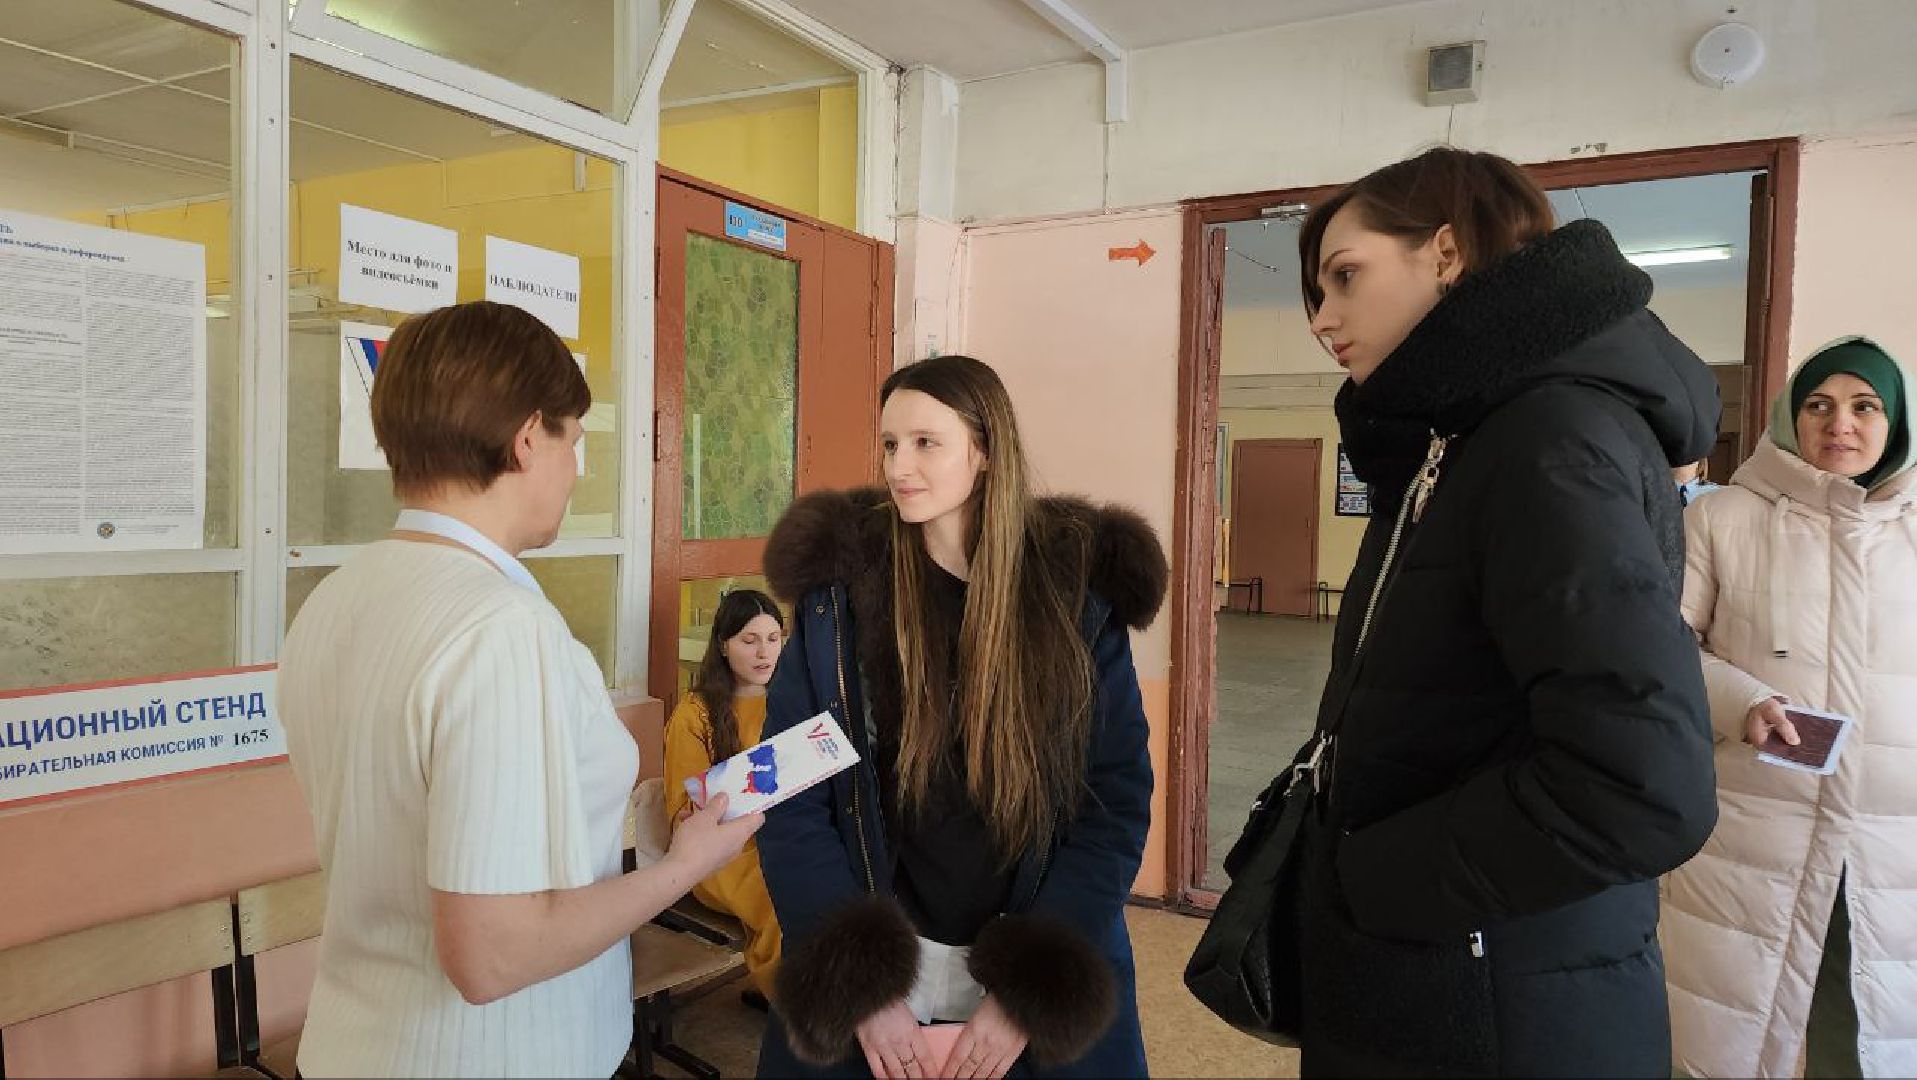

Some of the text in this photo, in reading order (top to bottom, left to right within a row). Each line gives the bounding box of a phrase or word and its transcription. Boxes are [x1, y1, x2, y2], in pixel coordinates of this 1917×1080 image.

[347, 240, 453, 273] Место для фото и
[360, 265, 439, 290] видеосъёмки
[489, 274, 577, 302] НАБЛЮДАТЕЛИ
[0, 692, 267, 750] ЦИОННЫЙ СТЕНД
[121, 737, 206, 761] КОМИССИЯ
[233, 729, 269, 746] 1675
